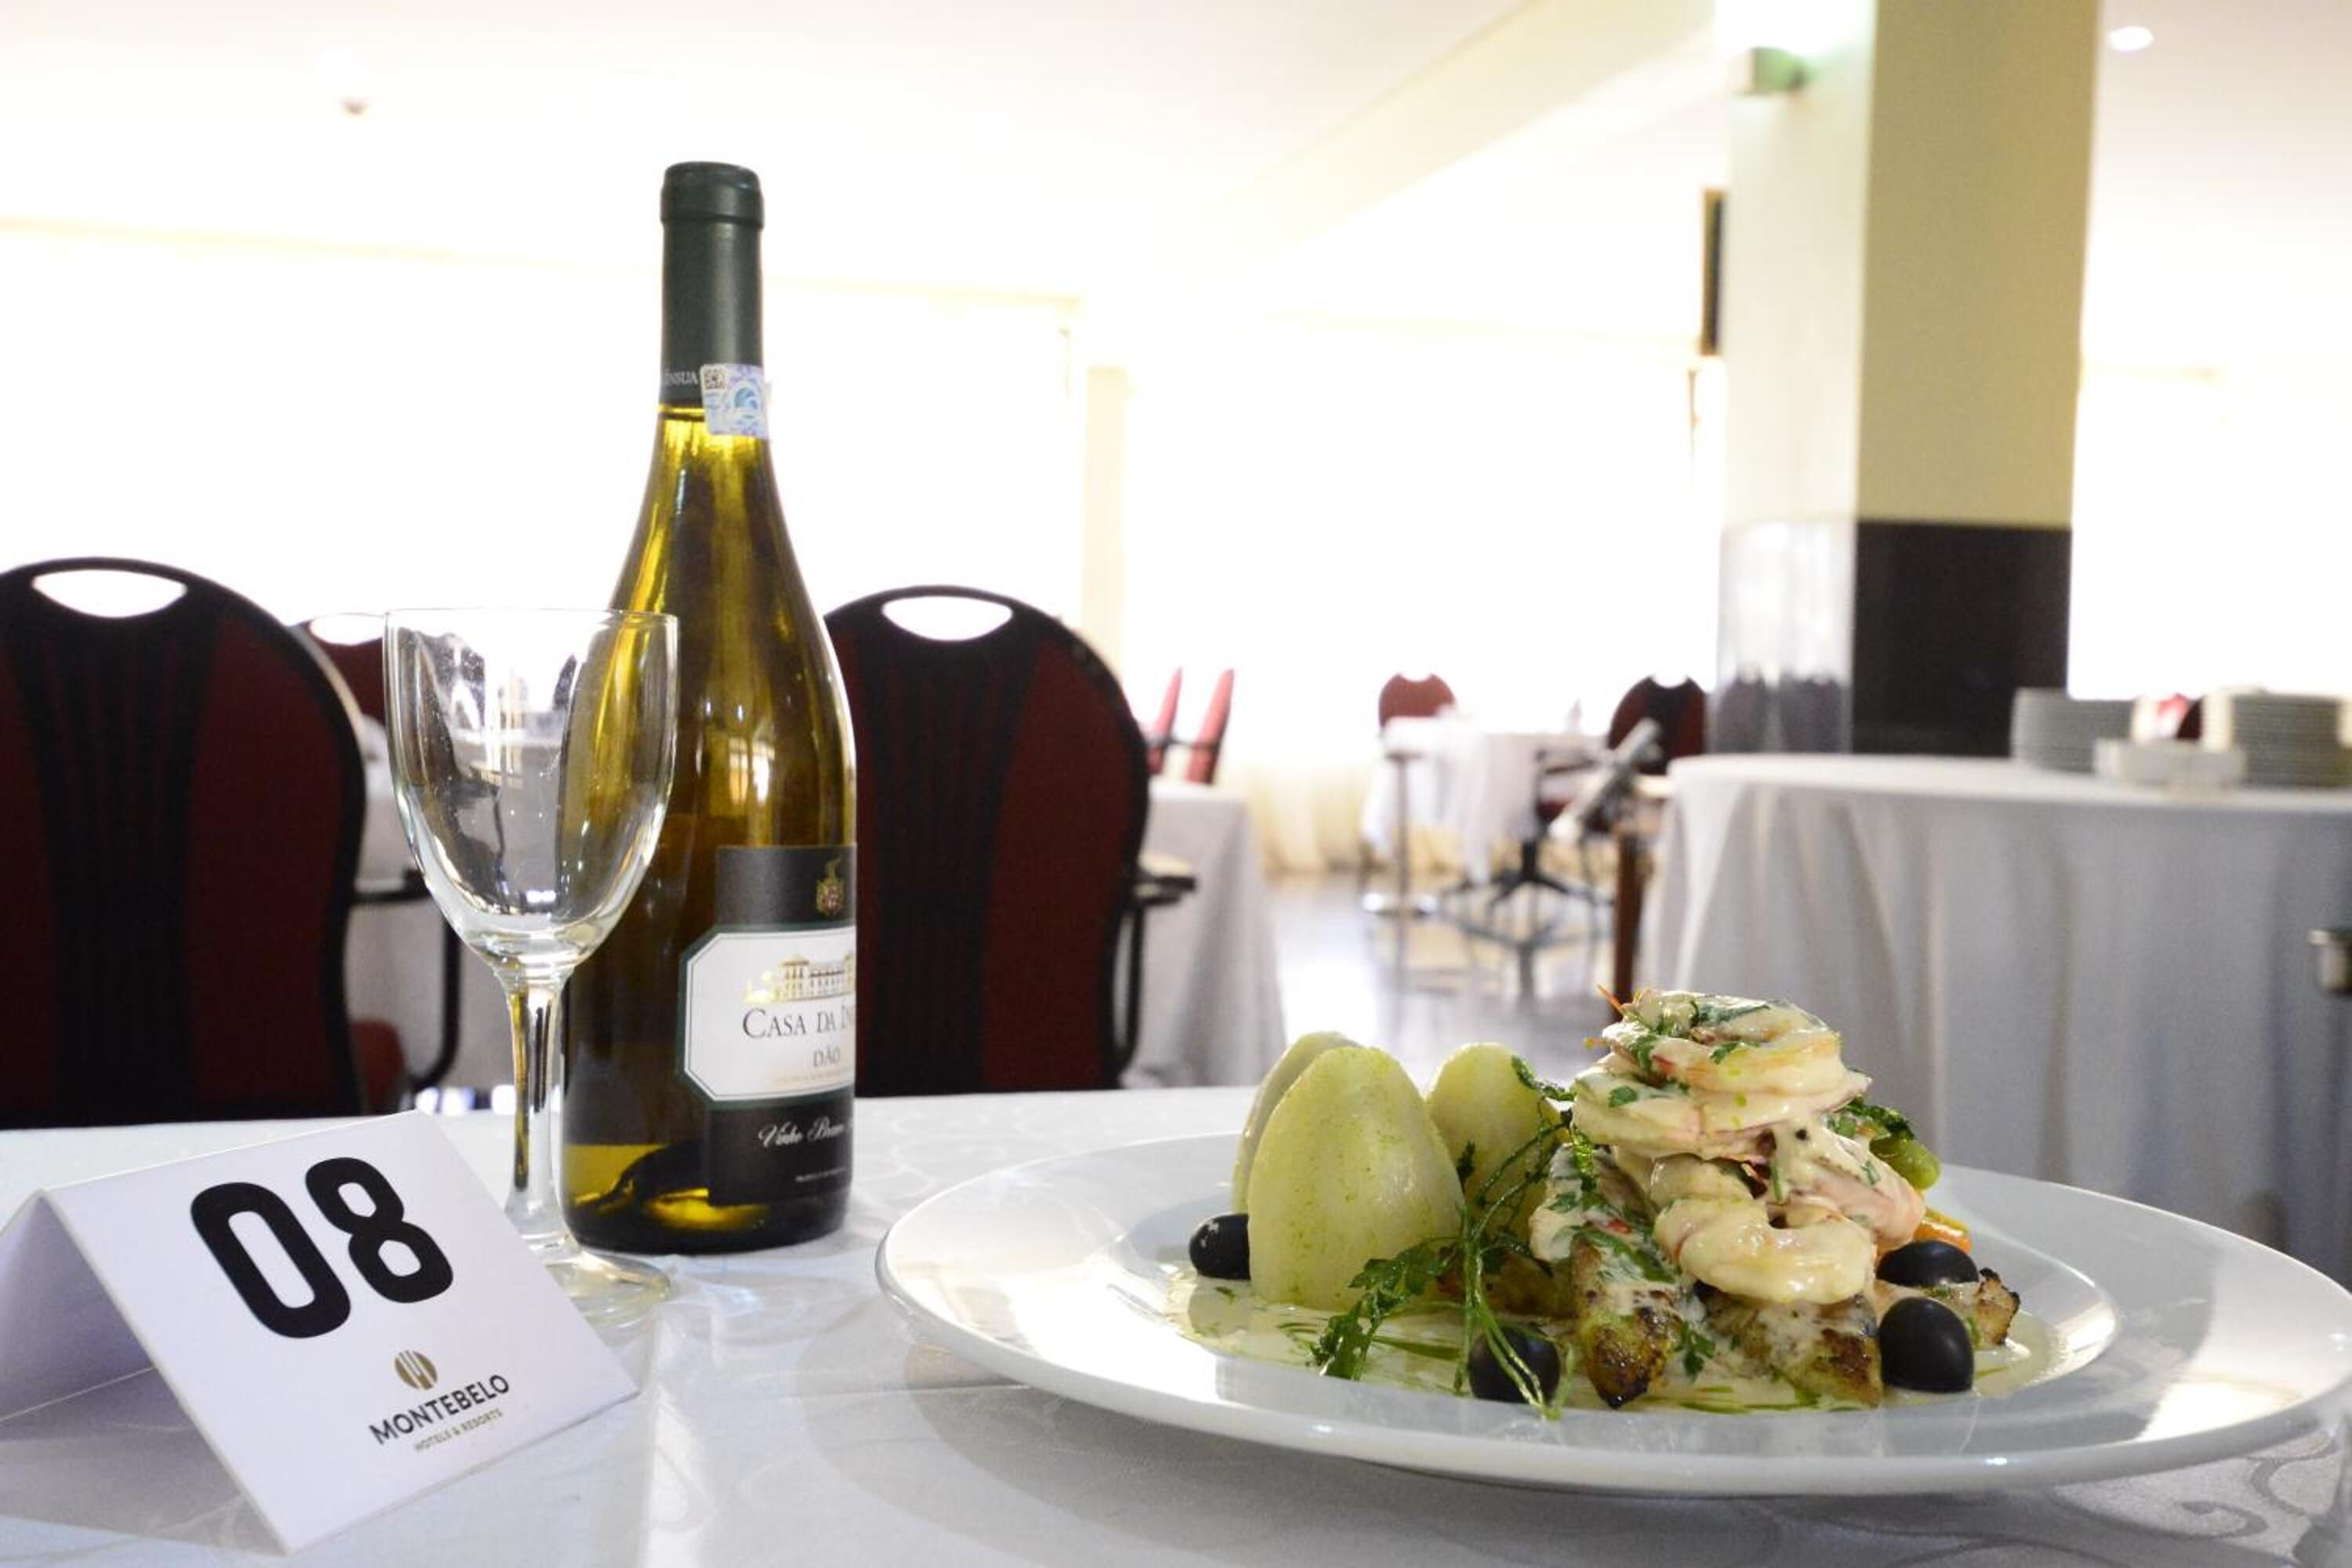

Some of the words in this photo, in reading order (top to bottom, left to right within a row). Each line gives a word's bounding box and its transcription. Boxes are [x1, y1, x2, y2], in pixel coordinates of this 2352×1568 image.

[742, 1007, 806, 1039] CASA
[191, 1157, 453, 1338] 08
[368, 1374, 510, 1445] MONTEBELO
